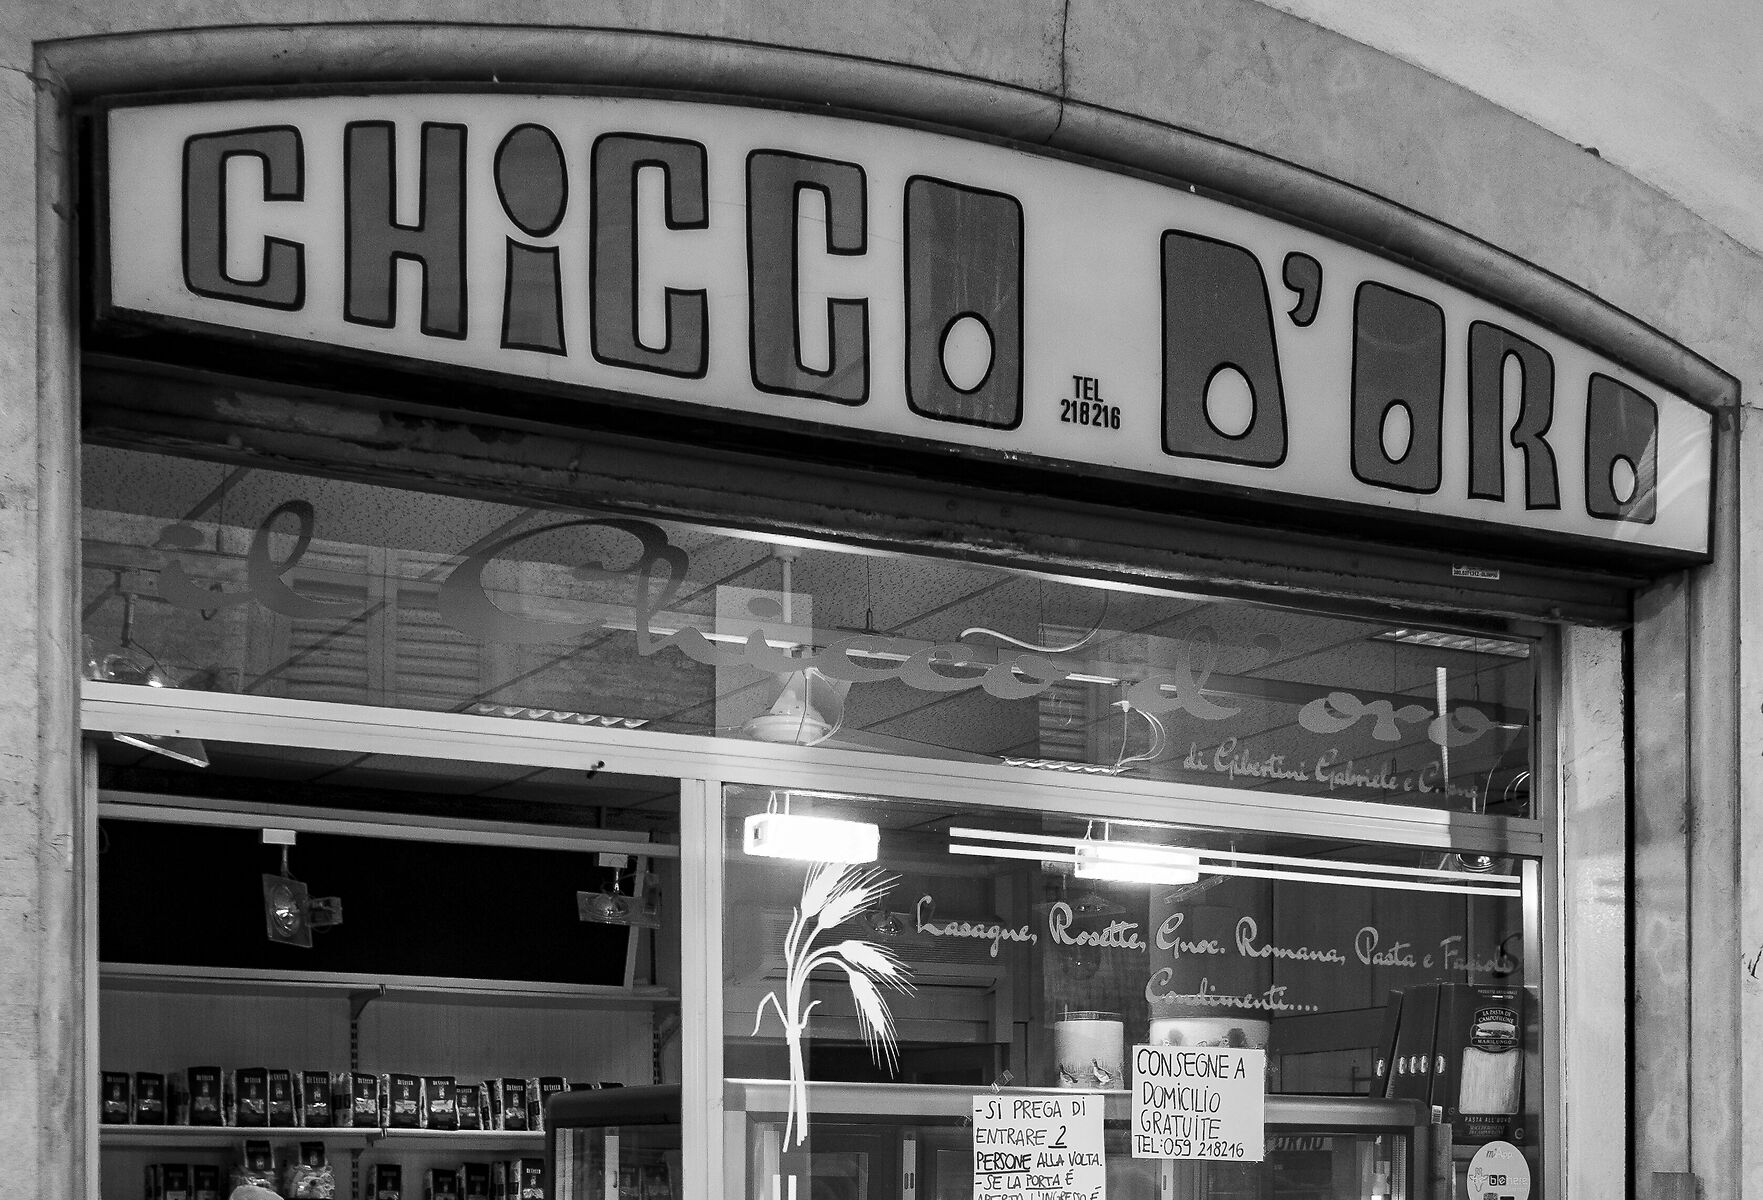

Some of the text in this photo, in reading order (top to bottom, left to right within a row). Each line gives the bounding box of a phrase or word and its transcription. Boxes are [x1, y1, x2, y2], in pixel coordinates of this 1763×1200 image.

[1073, 375, 1104, 402] TEL
[1161, 229, 1658, 525] D'ORO
[1183, 743, 1208, 771] di
[916, 895, 1037, 957] Lasagne,
[1049, 902, 1146, 952] Rosette,
[1235, 916, 1346, 966] Romana,
[1354, 926, 1417, 968] Pasta
[1423, 955, 1434, 969] e
[1137, 1048, 1246, 1079] CONSEGNE A
[1013, 1099, 1062, 1119] PREGA
[1072, 1096, 1086, 1117] DI
[1143, 1081, 1221, 1113] DOMICILIO
[976, 1125, 1067, 1147] ENTRARE 2
[1140, 1109, 1222, 1141] GRATUITE
[976, 1151, 1103, 1172] PERSONE ALLA VOLTA.
[1197, 1141, 1245, 1158] 218216
[1007, 1176, 1021, 1189] LA
[1026, 1173, 1061, 1188] PORTA
